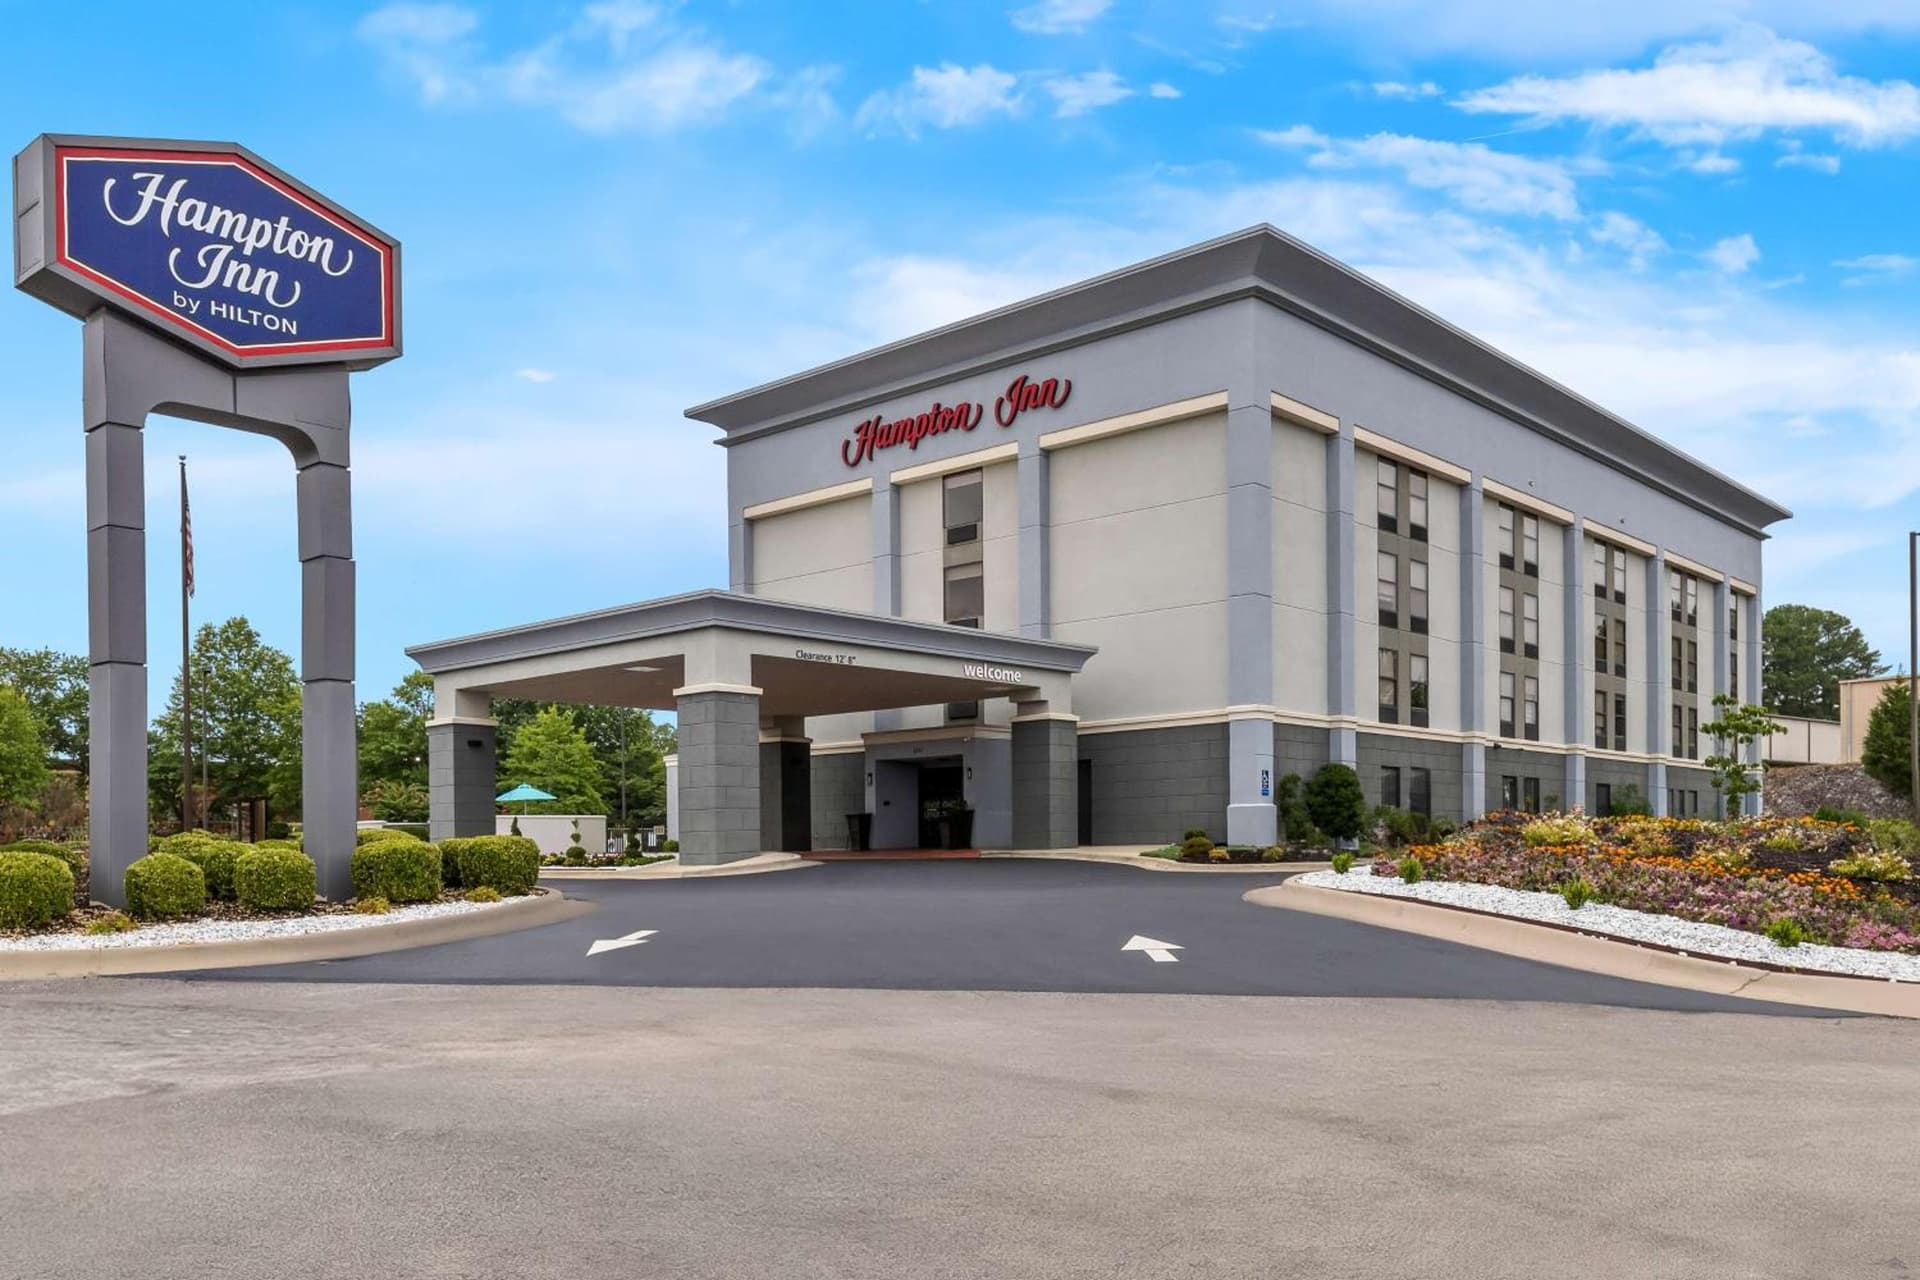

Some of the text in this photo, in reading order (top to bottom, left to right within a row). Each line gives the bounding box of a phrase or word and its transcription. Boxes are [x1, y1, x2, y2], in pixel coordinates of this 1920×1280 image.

[104, 172, 352, 276] Hampton
[168, 244, 300, 308] Inn
[173, 290, 297, 335] by HILTON
[842, 375, 1072, 467] Hampton Inn
[795, 649, 833, 662] Clearance
[964, 663, 1021, 682] welcome
